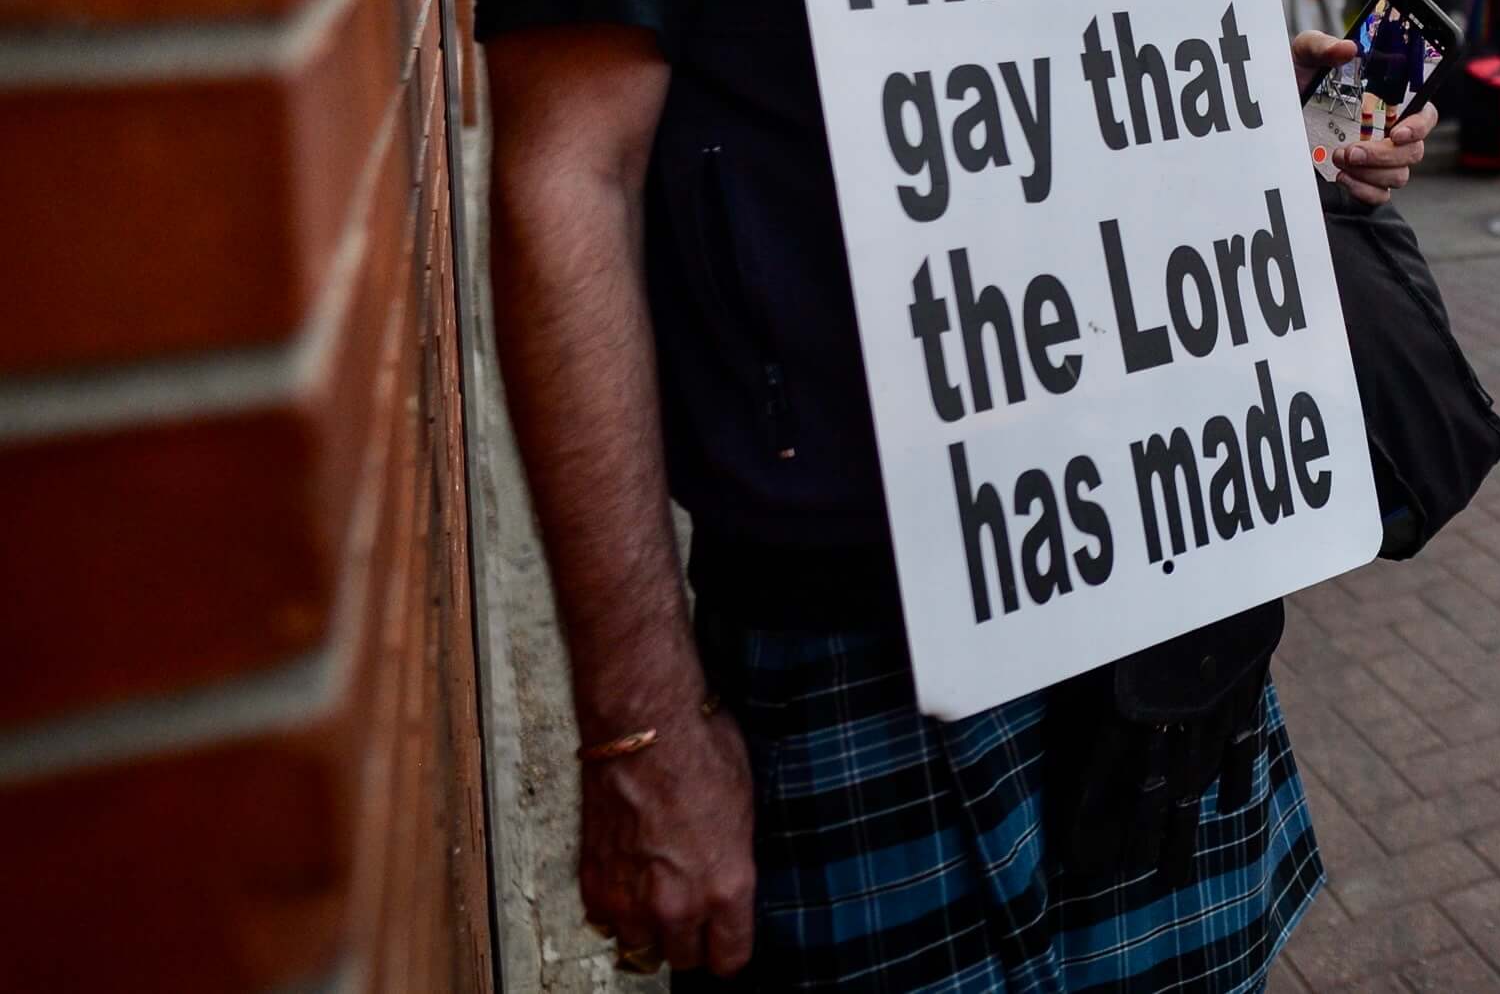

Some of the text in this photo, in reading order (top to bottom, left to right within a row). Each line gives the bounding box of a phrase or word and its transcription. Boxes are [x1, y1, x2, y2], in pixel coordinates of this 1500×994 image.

[882, 1, 1264, 223] gay that
[908, 188, 1307, 423] the Lord
[948, 359, 1333, 625] has made
